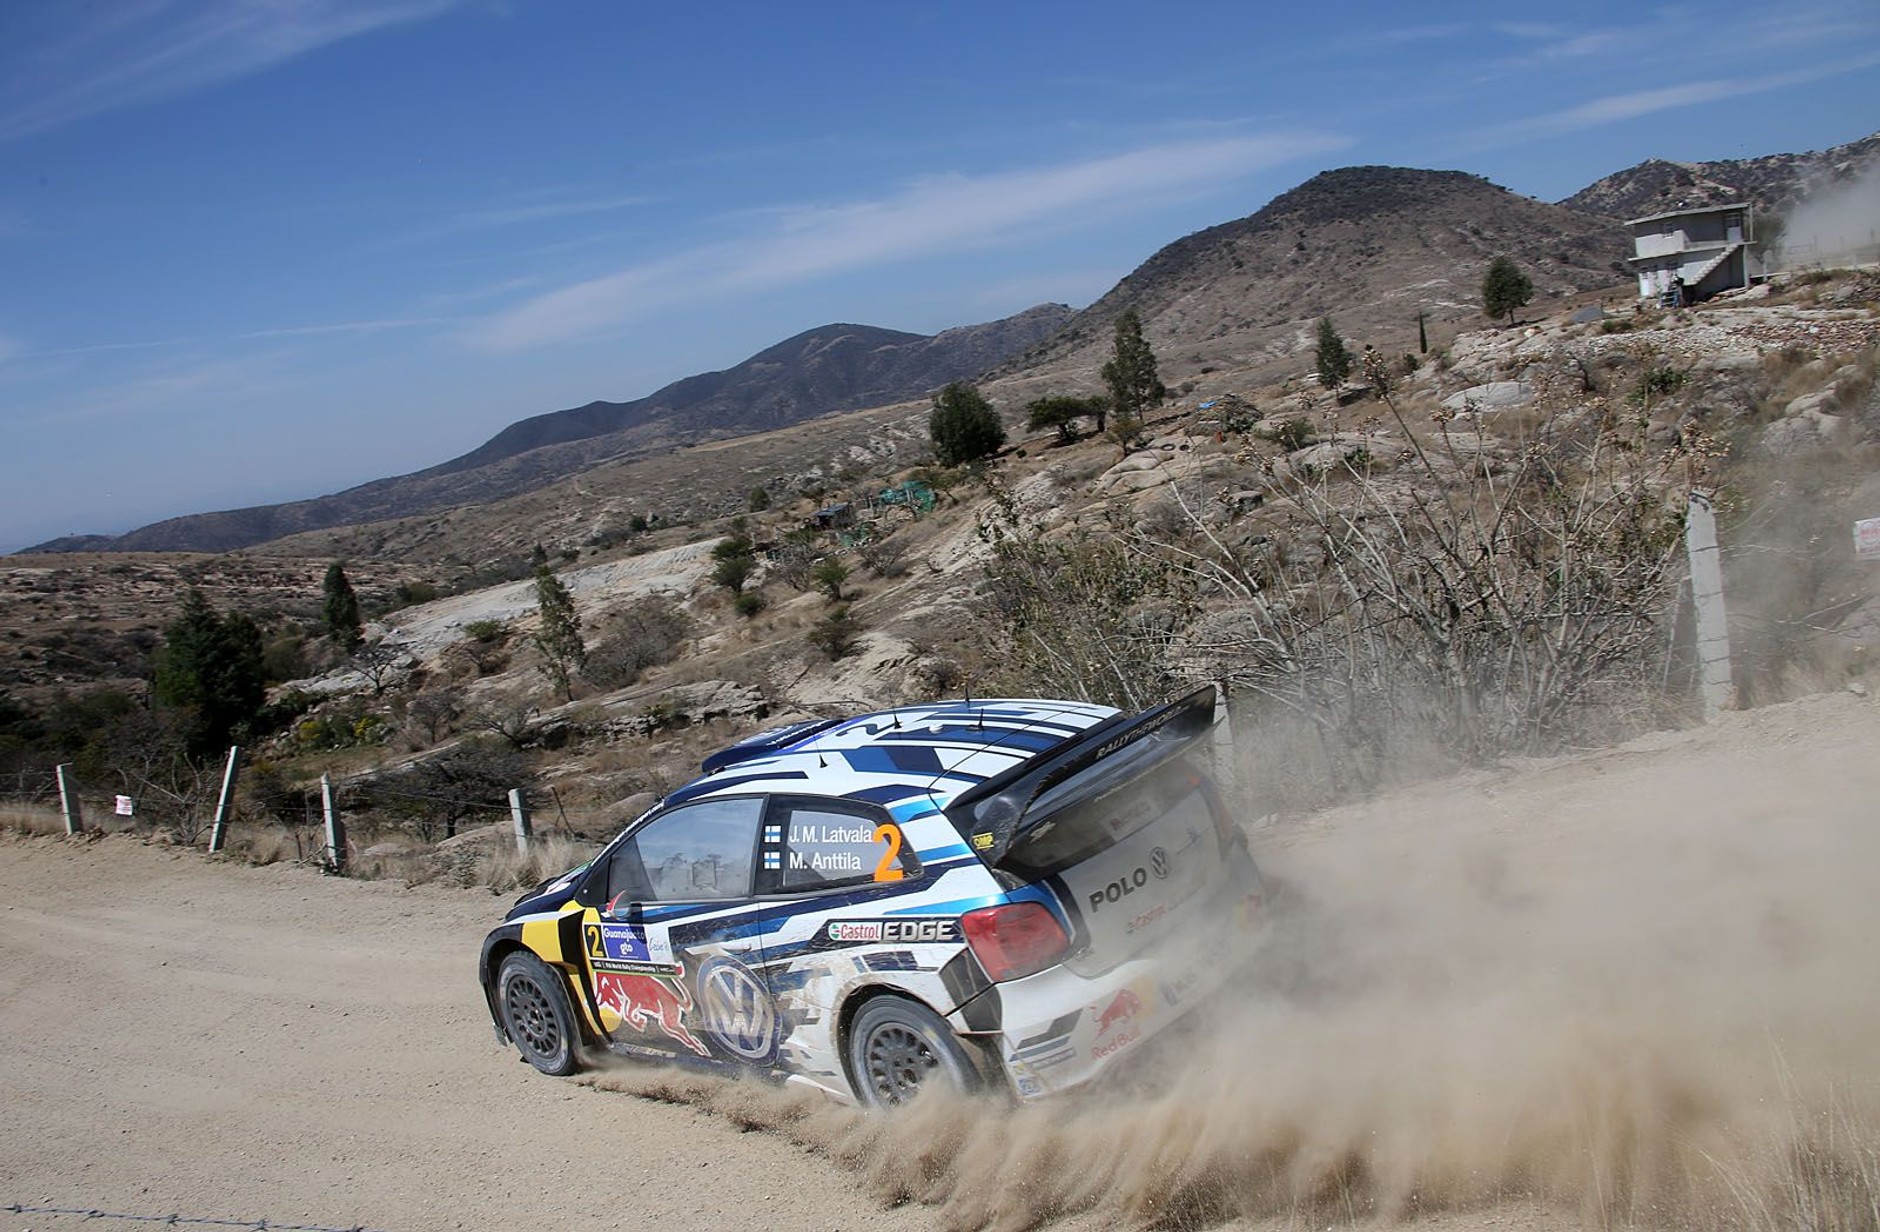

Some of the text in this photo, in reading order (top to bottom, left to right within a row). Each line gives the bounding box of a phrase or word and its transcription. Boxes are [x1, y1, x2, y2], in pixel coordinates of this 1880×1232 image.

[802, 825, 818, 843] M.
[822, 825, 873, 843] Latvala
[789, 852, 862, 870] M. Anttila
[872, 823, 904, 882] 2
[1089, 867, 1147, 913] POLO
[587, 925, 604, 957] 2
[840, 920, 957, 940] Castrol EDGE
